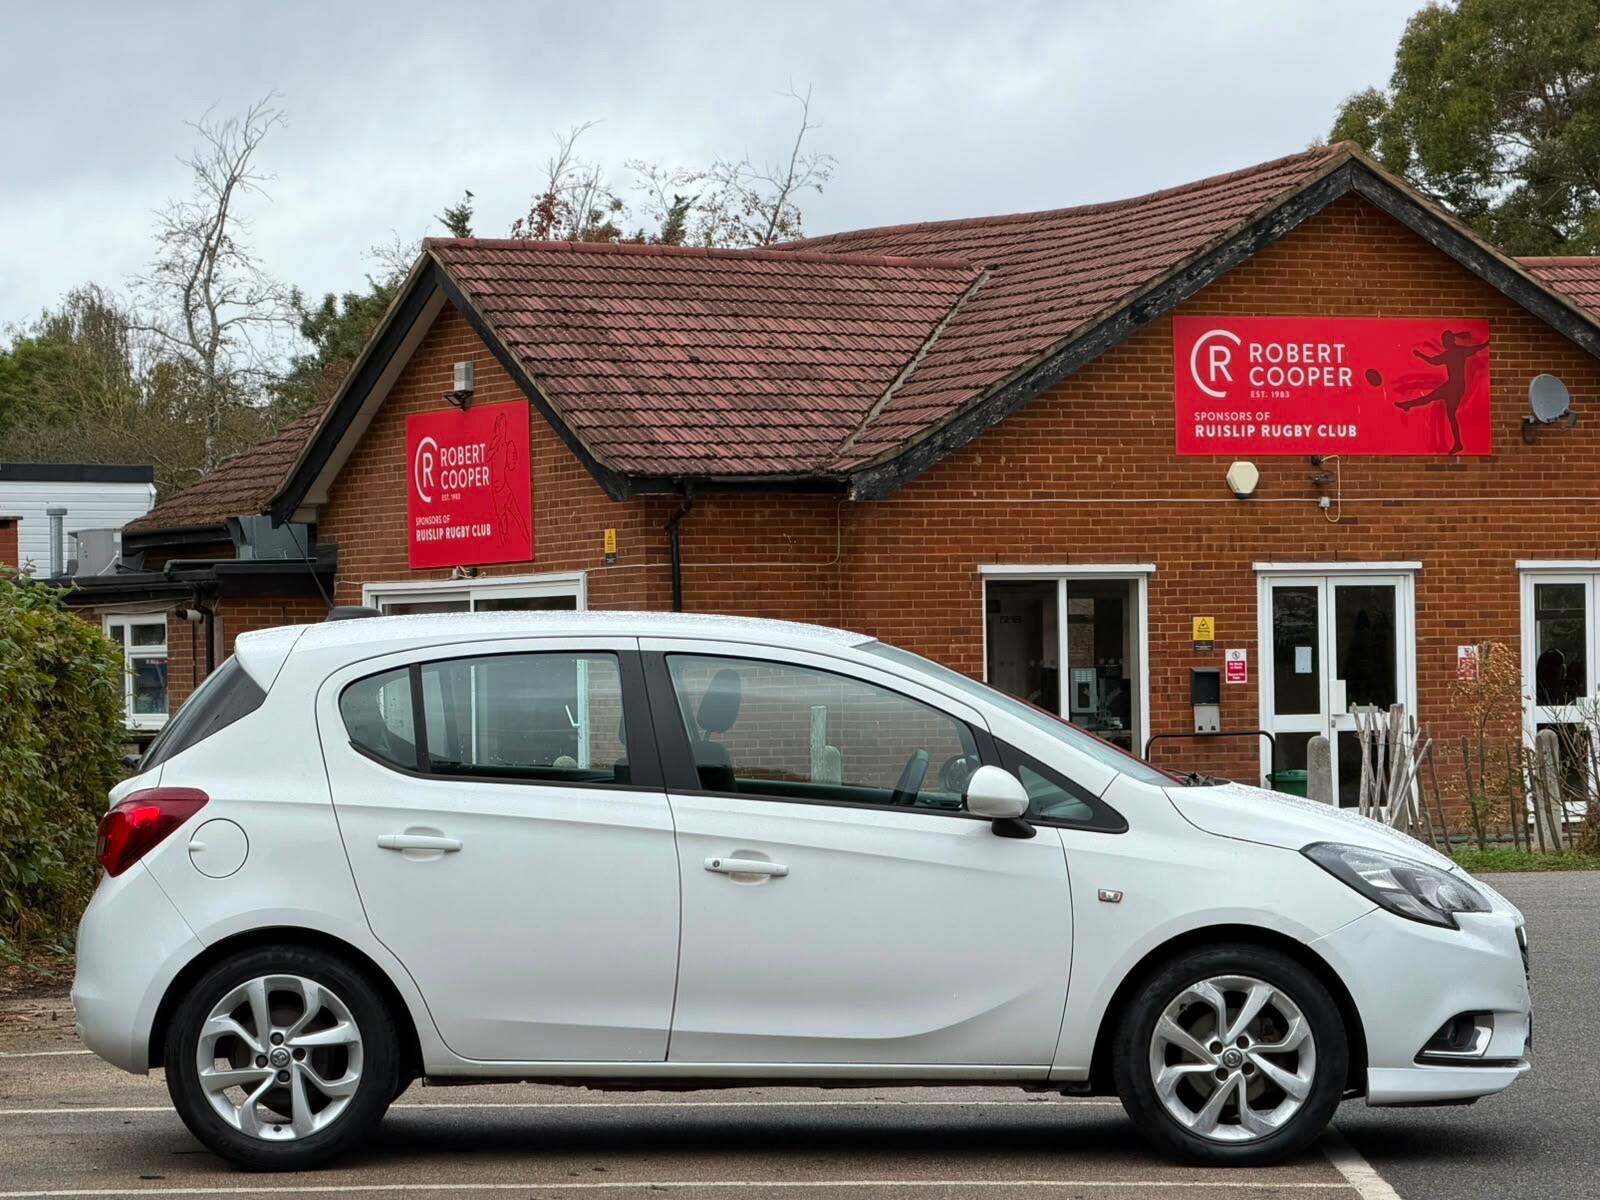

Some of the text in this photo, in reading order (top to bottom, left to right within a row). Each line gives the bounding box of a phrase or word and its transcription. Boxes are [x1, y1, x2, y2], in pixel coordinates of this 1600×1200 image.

[1249, 343, 1345, 364] ROBERT
[1249, 366, 1352, 387] COOPER
[1250, 390, 1269, 399] EST.
[1194, 411, 1271, 421] SPONSORS OF
[1195, 424, 1357, 437] RUISLIP RUGBY CLUB
[440, 443, 486, 467] ROBERT
[440, 466, 490, 490] COOPER
[415, 514, 451, 526] SPONSORS OF
[416, 523, 492, 542] RUISLIP RUGBY CLUB
